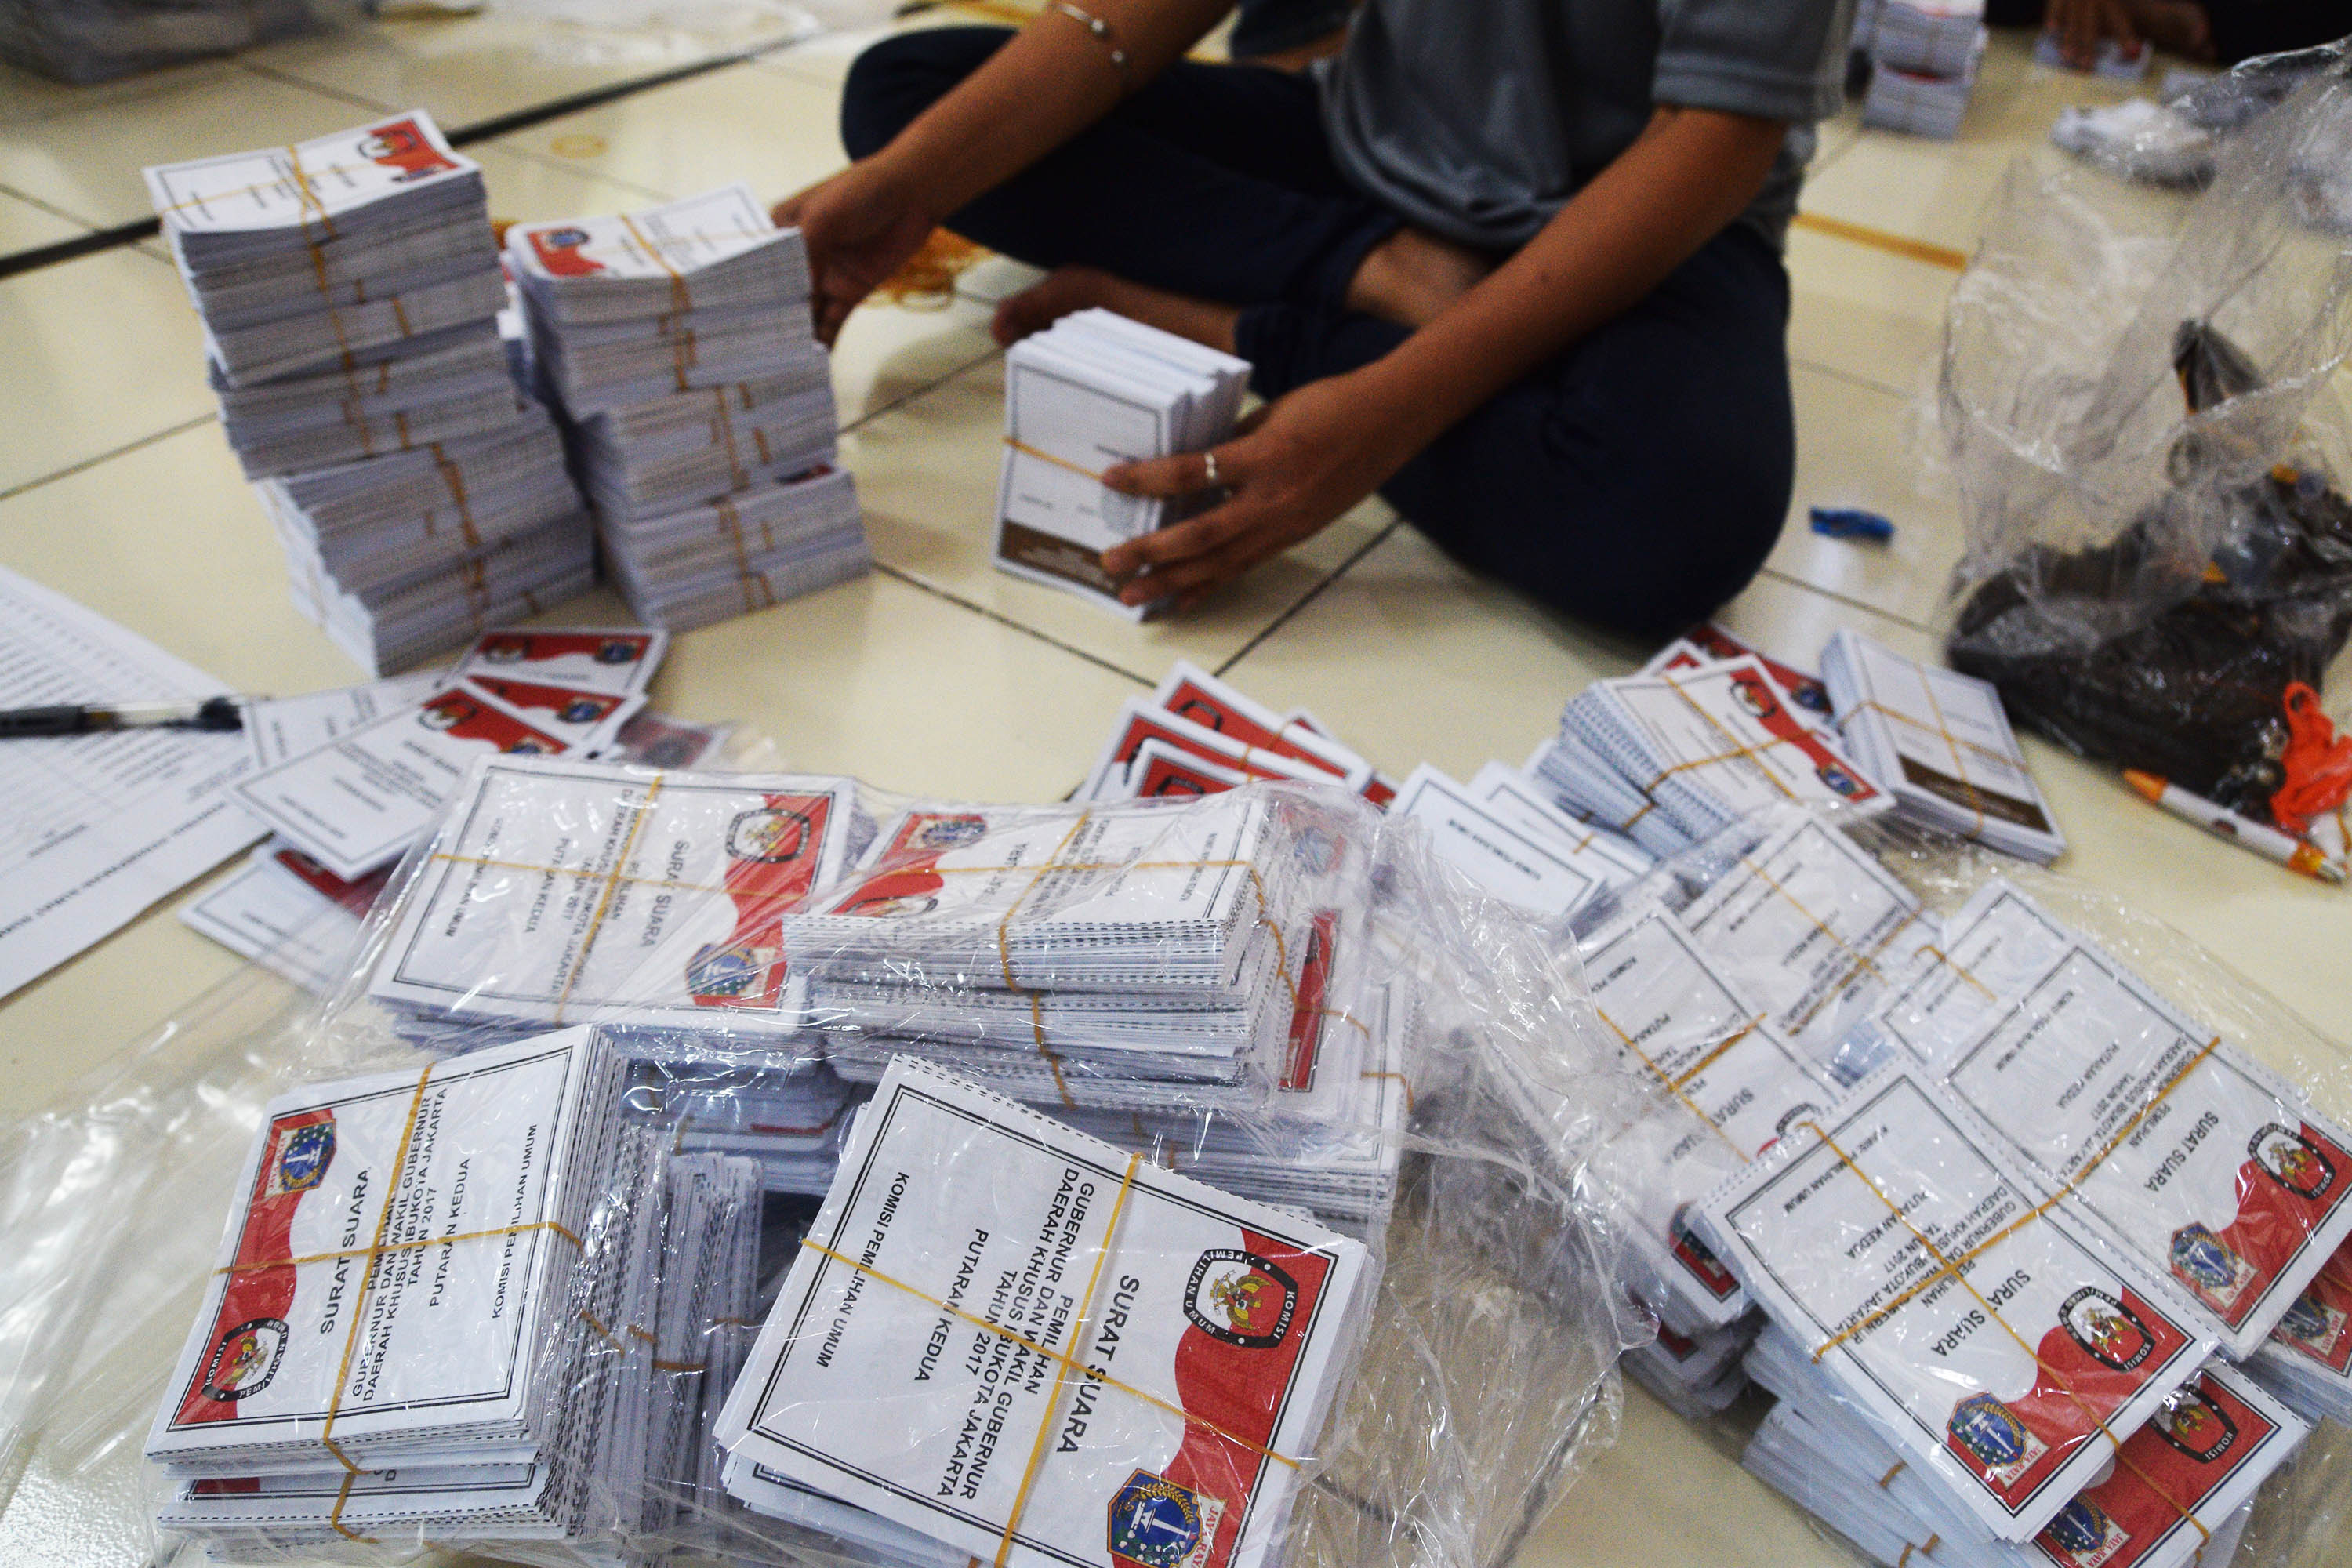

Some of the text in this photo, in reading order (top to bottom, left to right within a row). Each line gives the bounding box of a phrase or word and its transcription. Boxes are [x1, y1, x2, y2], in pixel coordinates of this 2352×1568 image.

[605, 789, 635, 836] DERAH
[639, 895, 672, 949] SUARA
[2142, 1110, 2220, 1195] SURAT SUARA
[419, 1185, 439, 1223] 2017
[447, 1157, 472, 1218] KEDUA
[875, 1171, 910, 1228] KOMISI
[1037, 1167, 1080, 1243] DAERAH
[350, 1095, 434, 1396] GUBERNUR DAN WAKIL GUBERNUR
[362, 1087, 448, 1401] DAERAH KHUSUS IBUKOTA JAKARTA
[490, 1261, 512, 1319] KOMISI
[520, 1123, 538, 1171] UMUM
[1044, 1180, 1096, 1283] GUBERNUR
[1843, 1225, 1885, 1261] KEDUA
[1903, 1221, 1941, 1254] TAUN
[1958, 1199, 2018, 1250] GUBERNUR
[318, 1167, 375, 1334] SURAT SUARA
[1938, 1244, 1965, 1268] DA
[913, 1227, 989, 1385] PUTARAN KEDUA
[1006, 1244, 1049, 1322] KHUSUS
[1026, 1284, 1055, 1327] DAN
[1185, 1251, 1241, 1334] PEMILIHAN UMUM
[1272, 1290, 1294, 1339] KOMISI
[1833, 1290, 1886, 1338] JAKARTA
[1929, 1308, 1987, 1360] SUARA
[205, 1341, 227, 1384] KOMISI
[815, 1316, 848, 1368] UMUM
[962, 1331, 992, 1376] 2017
[1022, 1293, 1074, 1396] PEMILHAN
[1054, 1272, 1142, 1459] SURAT SUARA
[2122, 1341, 2153, 1371] KOMISI
[936, 1407, 985, 1501] JAKARTA
[959, 1389, 1014, 1502] GUBERNUR
[2003, 1443, 2043, 1483] JAYA RAYA
[2202, 1429, 2235, 1462] KOMISI
[2103, 1532, 2125, 1553] JAYA
